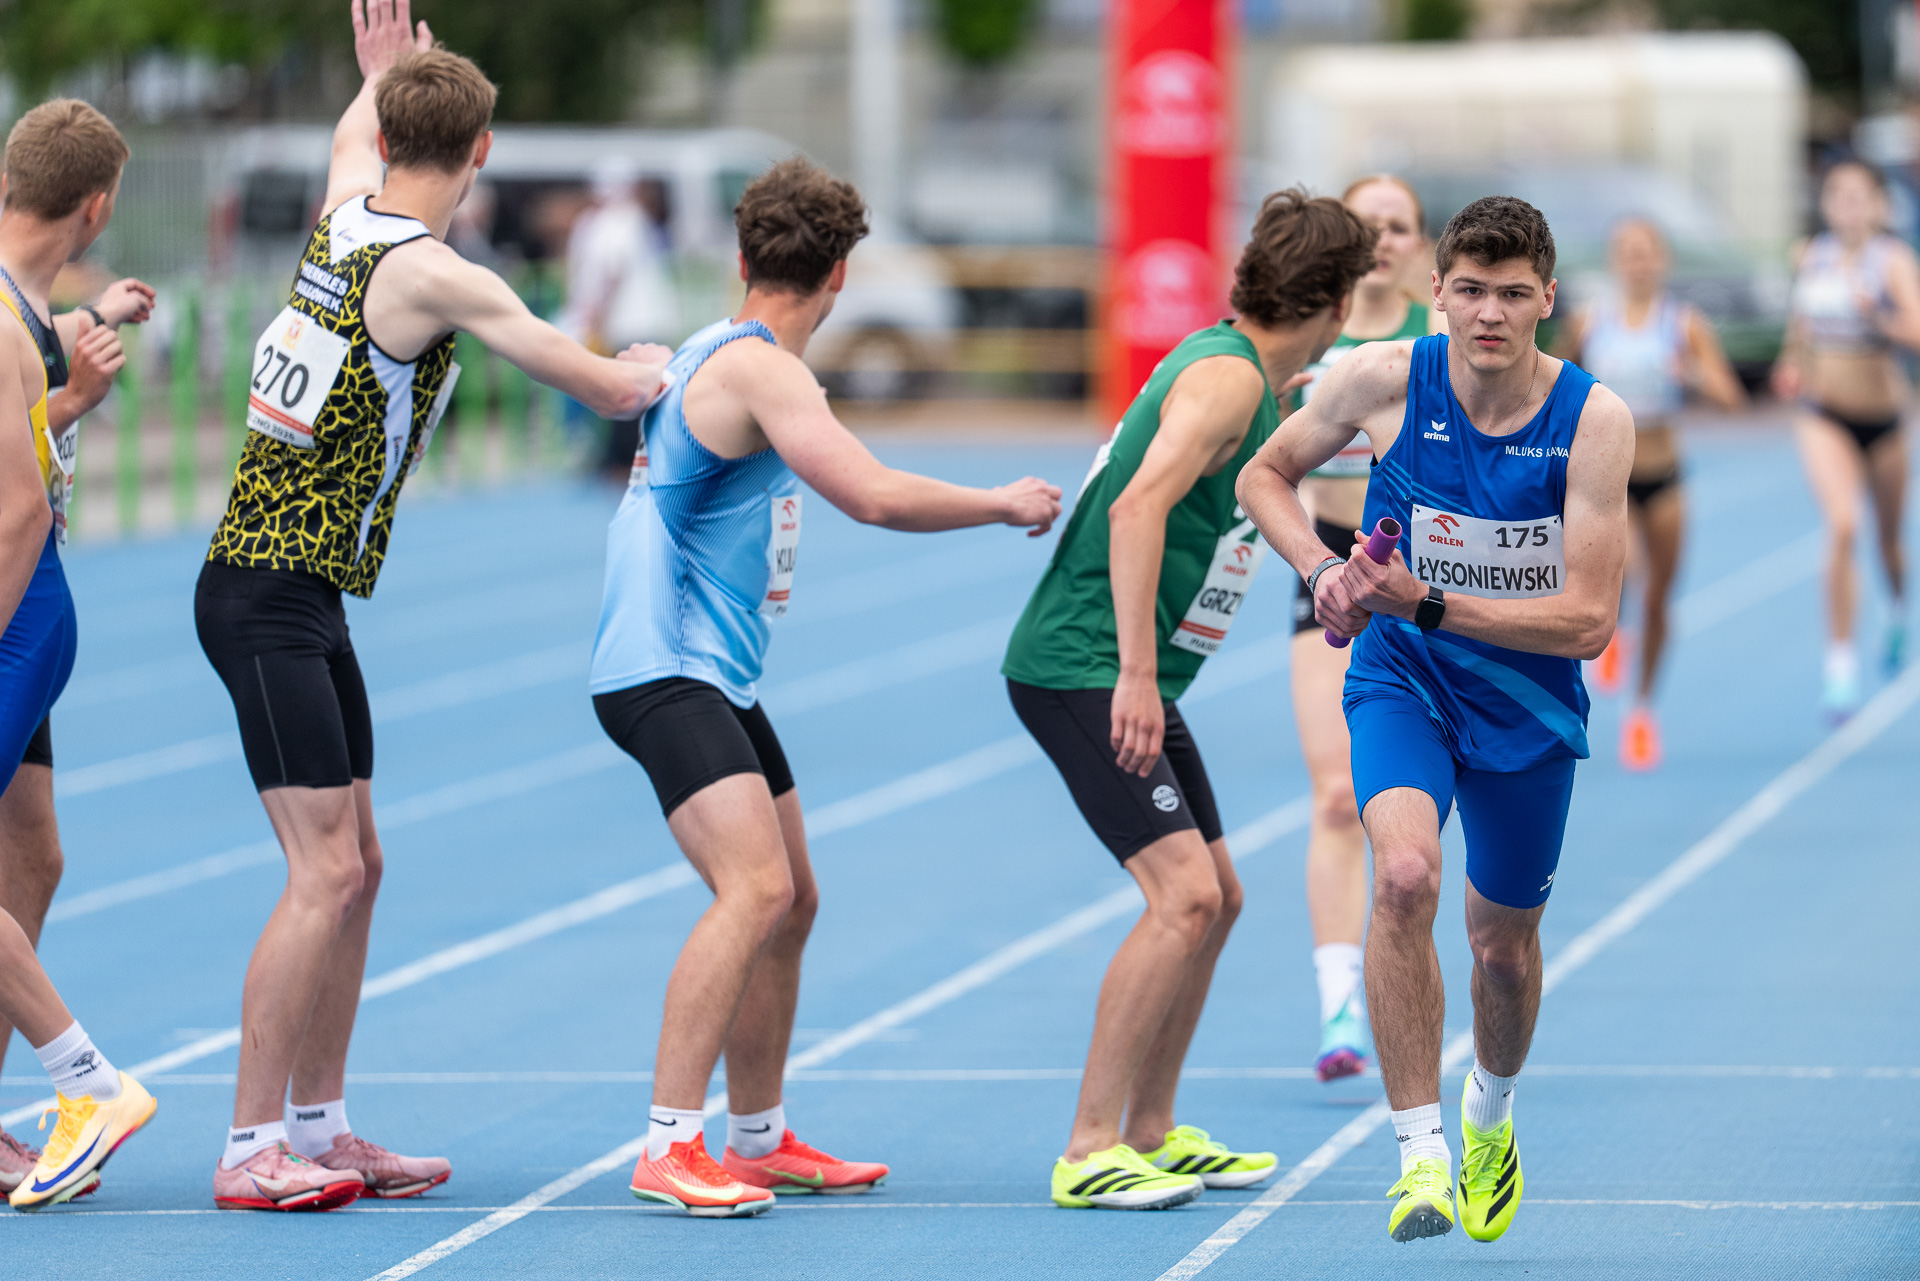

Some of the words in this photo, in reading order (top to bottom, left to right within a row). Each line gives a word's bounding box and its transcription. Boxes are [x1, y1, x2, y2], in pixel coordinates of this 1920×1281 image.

[300, 260, 349, 297] HERKULES
[252, 344, 309, 408] 270
[1424, 432, 1450, 442] erima
[1505, 445, 1543, 458] MLUKS
[1428, 534, 1464, 548] ORLEN
[1494, 525, 1549, 549] 175
[1418, 556, 1557, 591] ŁYSONIEWSKI
